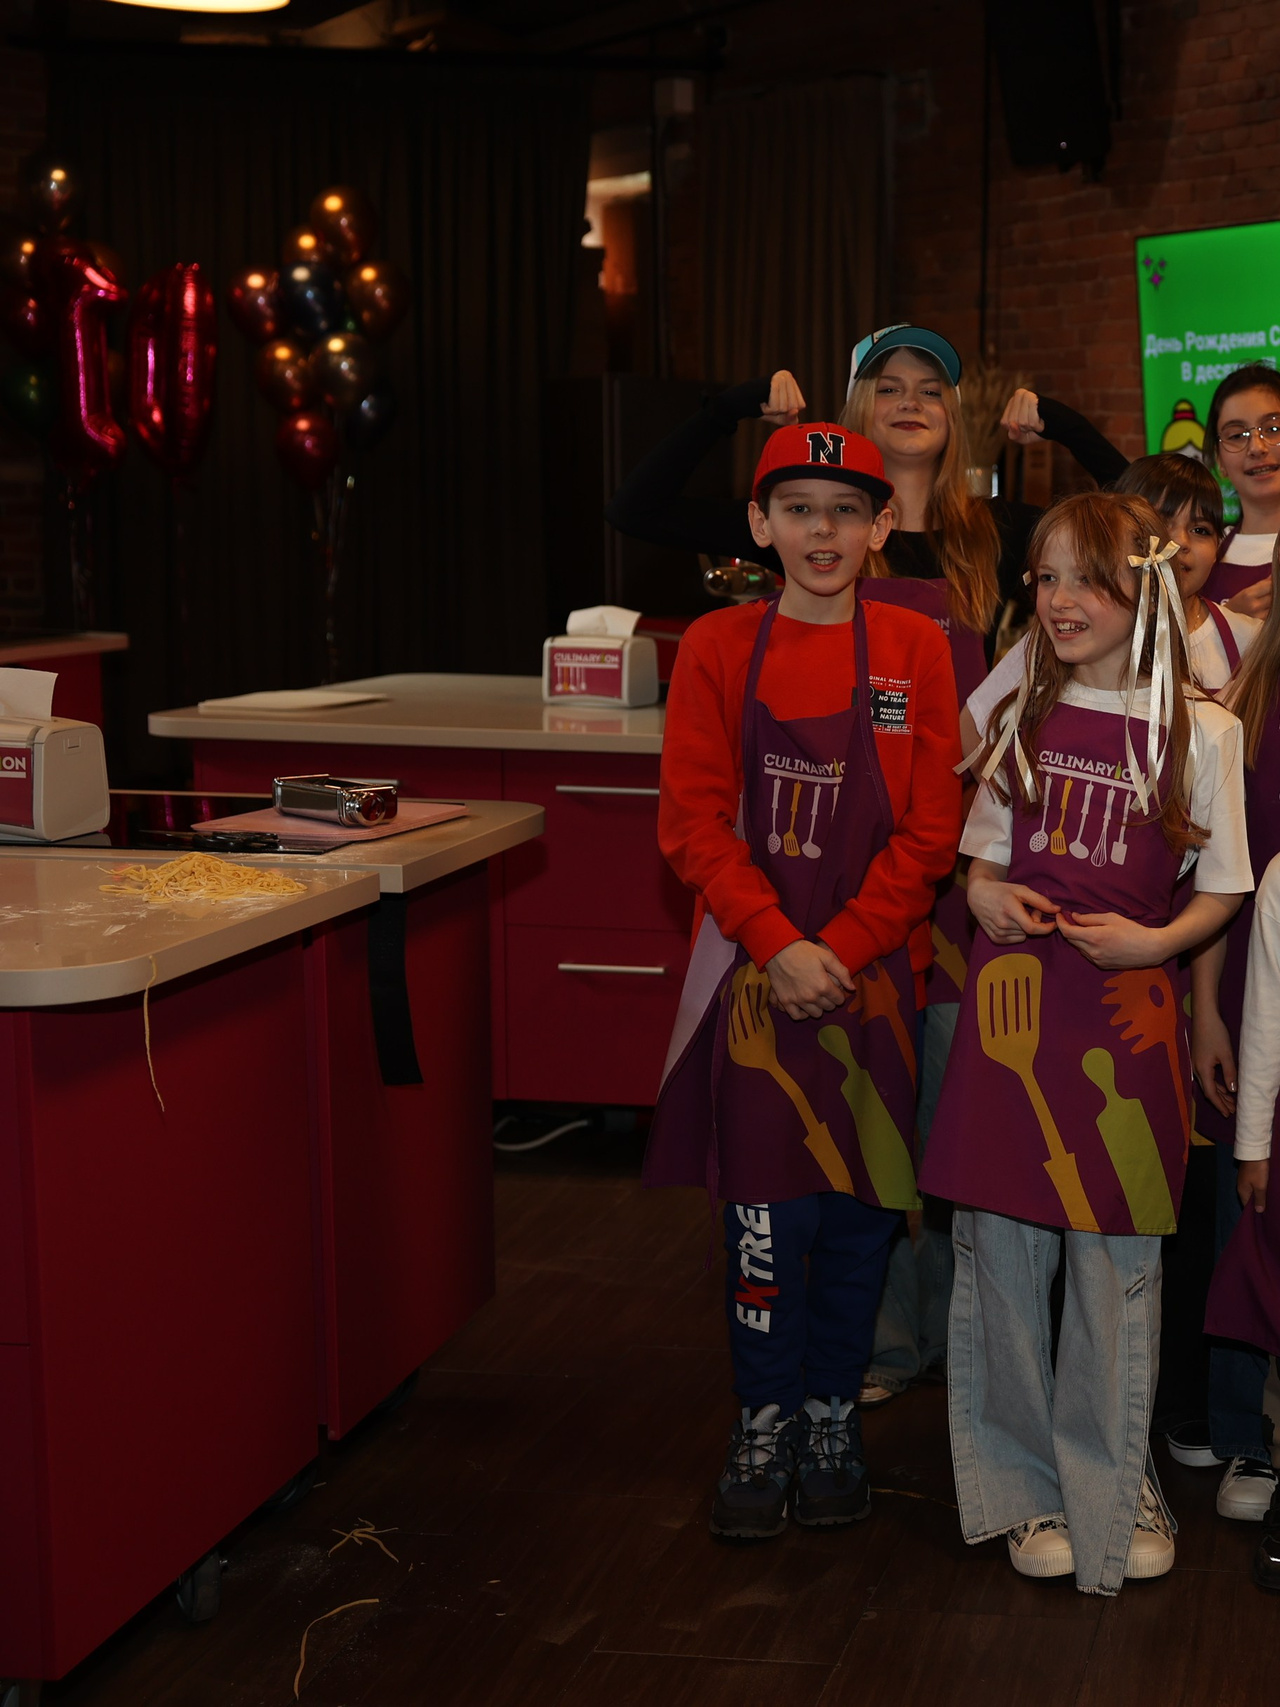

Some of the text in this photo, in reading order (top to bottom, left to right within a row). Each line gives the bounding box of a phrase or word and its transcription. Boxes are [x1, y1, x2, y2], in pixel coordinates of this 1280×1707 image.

[1145, 333, 1183, 358] День
[1185, 330, 1267, 353] Рождения
[805, 431, 846, 467] N
[879, 707, 906, 715] PROTECT
[734, 1202, 781, 1334] EXTRE
